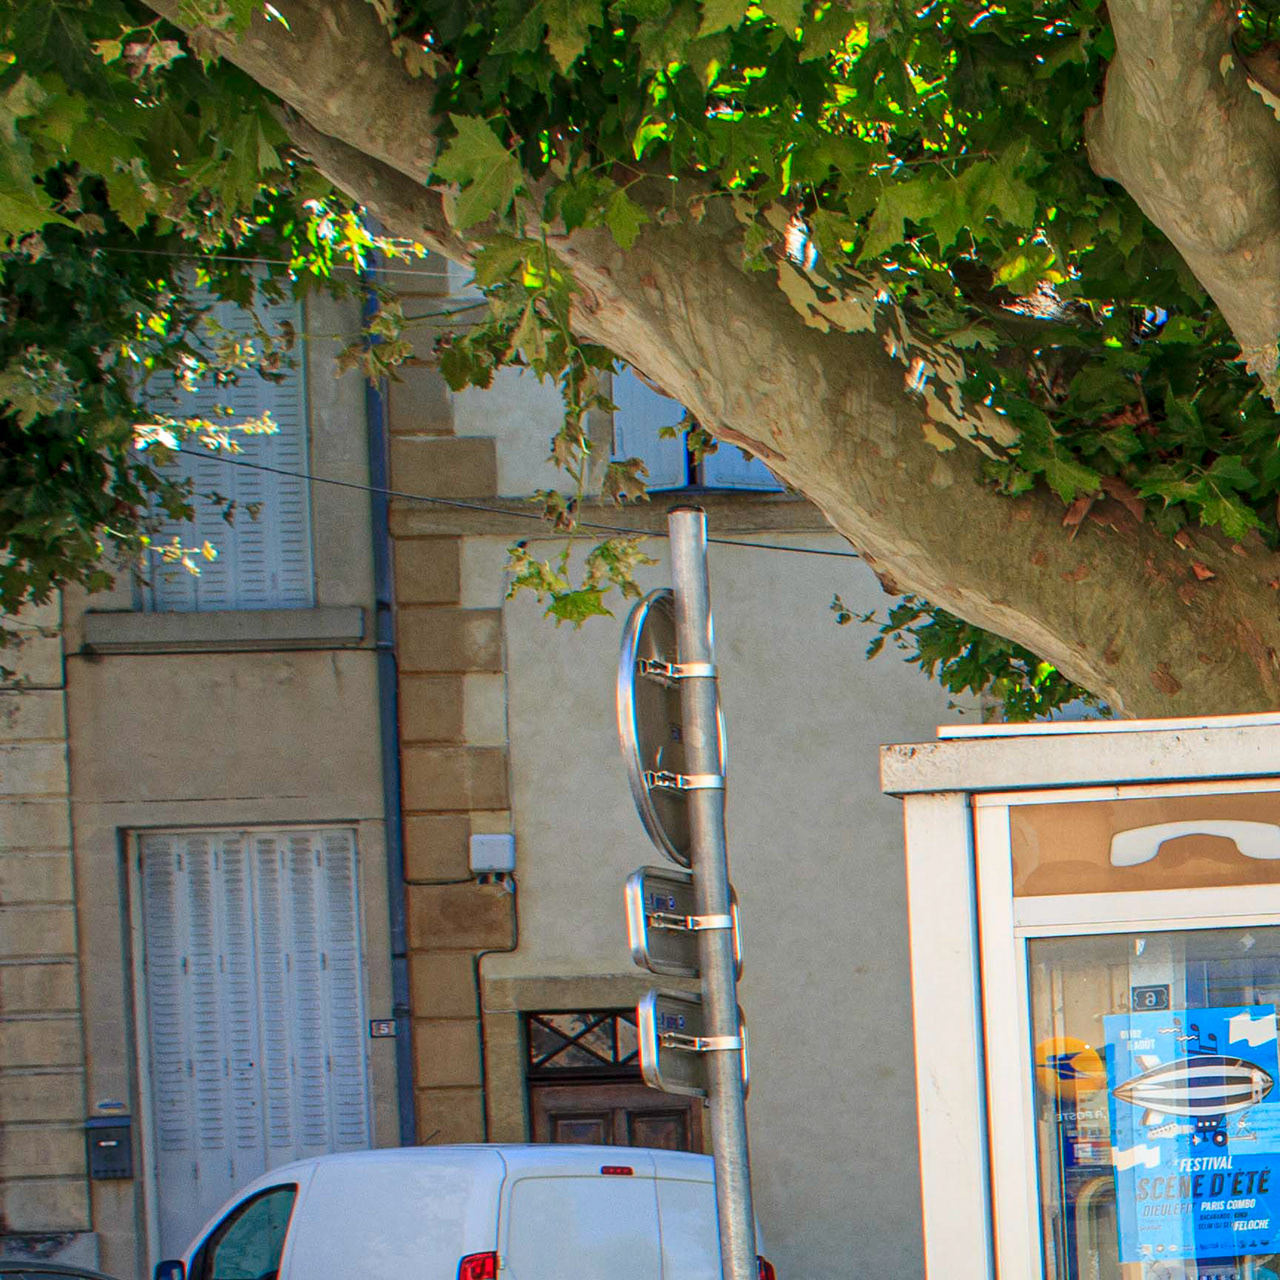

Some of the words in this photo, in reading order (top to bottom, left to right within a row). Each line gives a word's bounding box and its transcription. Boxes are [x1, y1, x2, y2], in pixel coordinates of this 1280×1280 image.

[1179, 1155, 1234, 1173] FESTIVAL
[1143, 1201, 1197, 1217] DIEULEFIT
[1200, 1200, 1225, 1211] PARIS
[1226, 1198, 1257, 1209] COMBO
